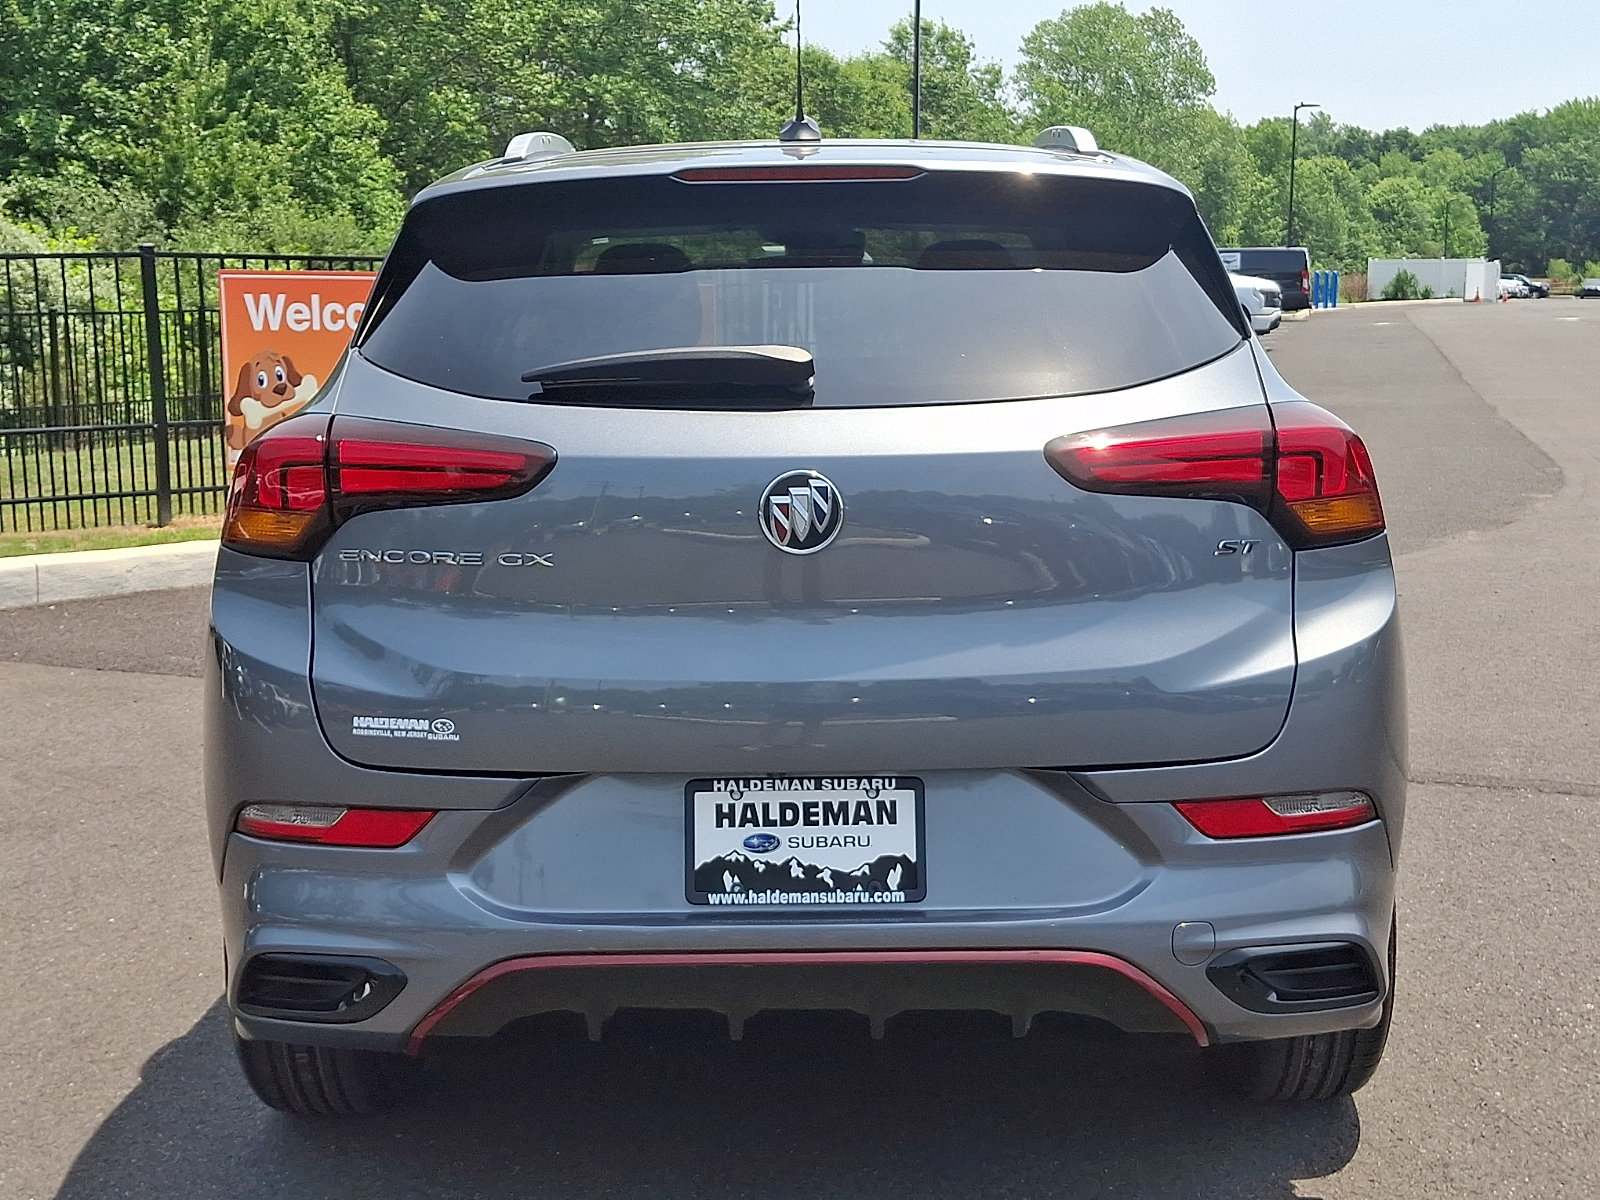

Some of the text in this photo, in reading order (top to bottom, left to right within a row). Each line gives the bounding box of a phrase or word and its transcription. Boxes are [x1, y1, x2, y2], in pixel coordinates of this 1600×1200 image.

[1213, 539, 1261, 555] ST
[339, 549, 554, 566] ENCORE GX
[353, 716, 429, 731] HALDEMAN
[713, 778, 896, 792] HALDEMAN SUBARU
[715, 799, 897, 828] HALDEMAN
[788, 835, 871, 849] SUBARU
[708, 889, 905, 905] www.haldemansubaru.com
